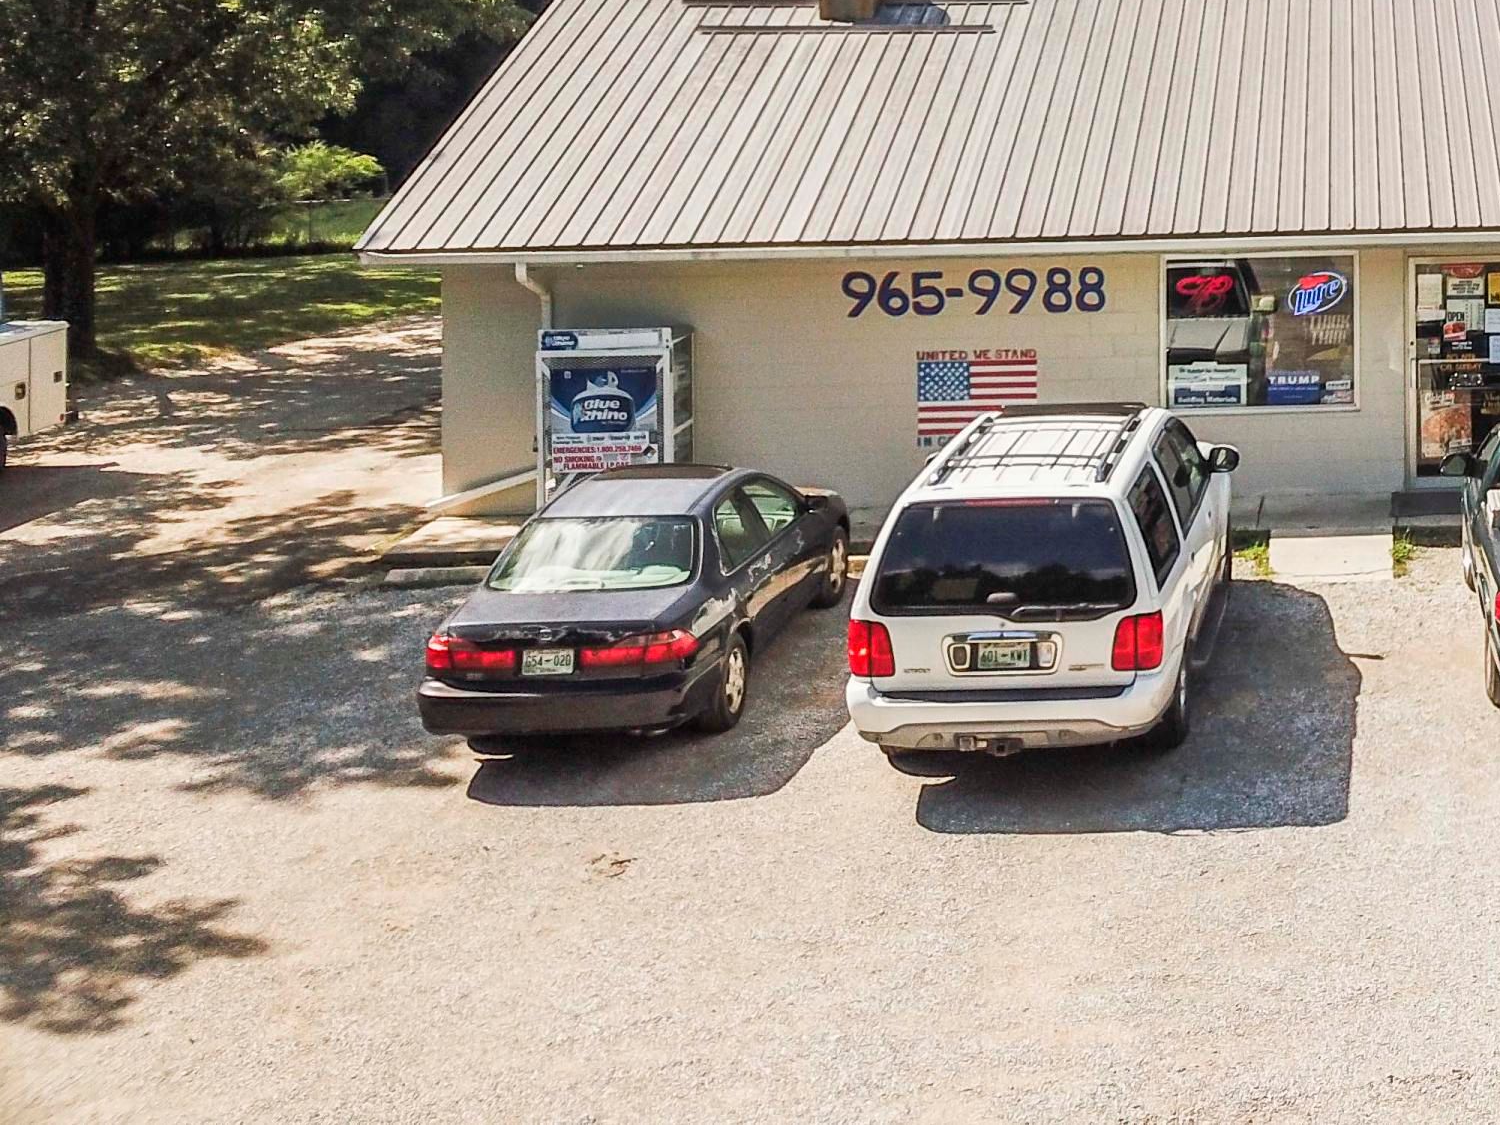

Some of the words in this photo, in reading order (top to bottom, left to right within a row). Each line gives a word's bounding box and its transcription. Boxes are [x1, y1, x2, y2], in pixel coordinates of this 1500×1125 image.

[841, 266, 1106, 317] 965-9988
[916, 350, 968, 360] UNITED
[974, 350, 991, 359] WE
[996, 349, 1037, 359] STAND
[1268, 376, 1320, 385] TRUMP
